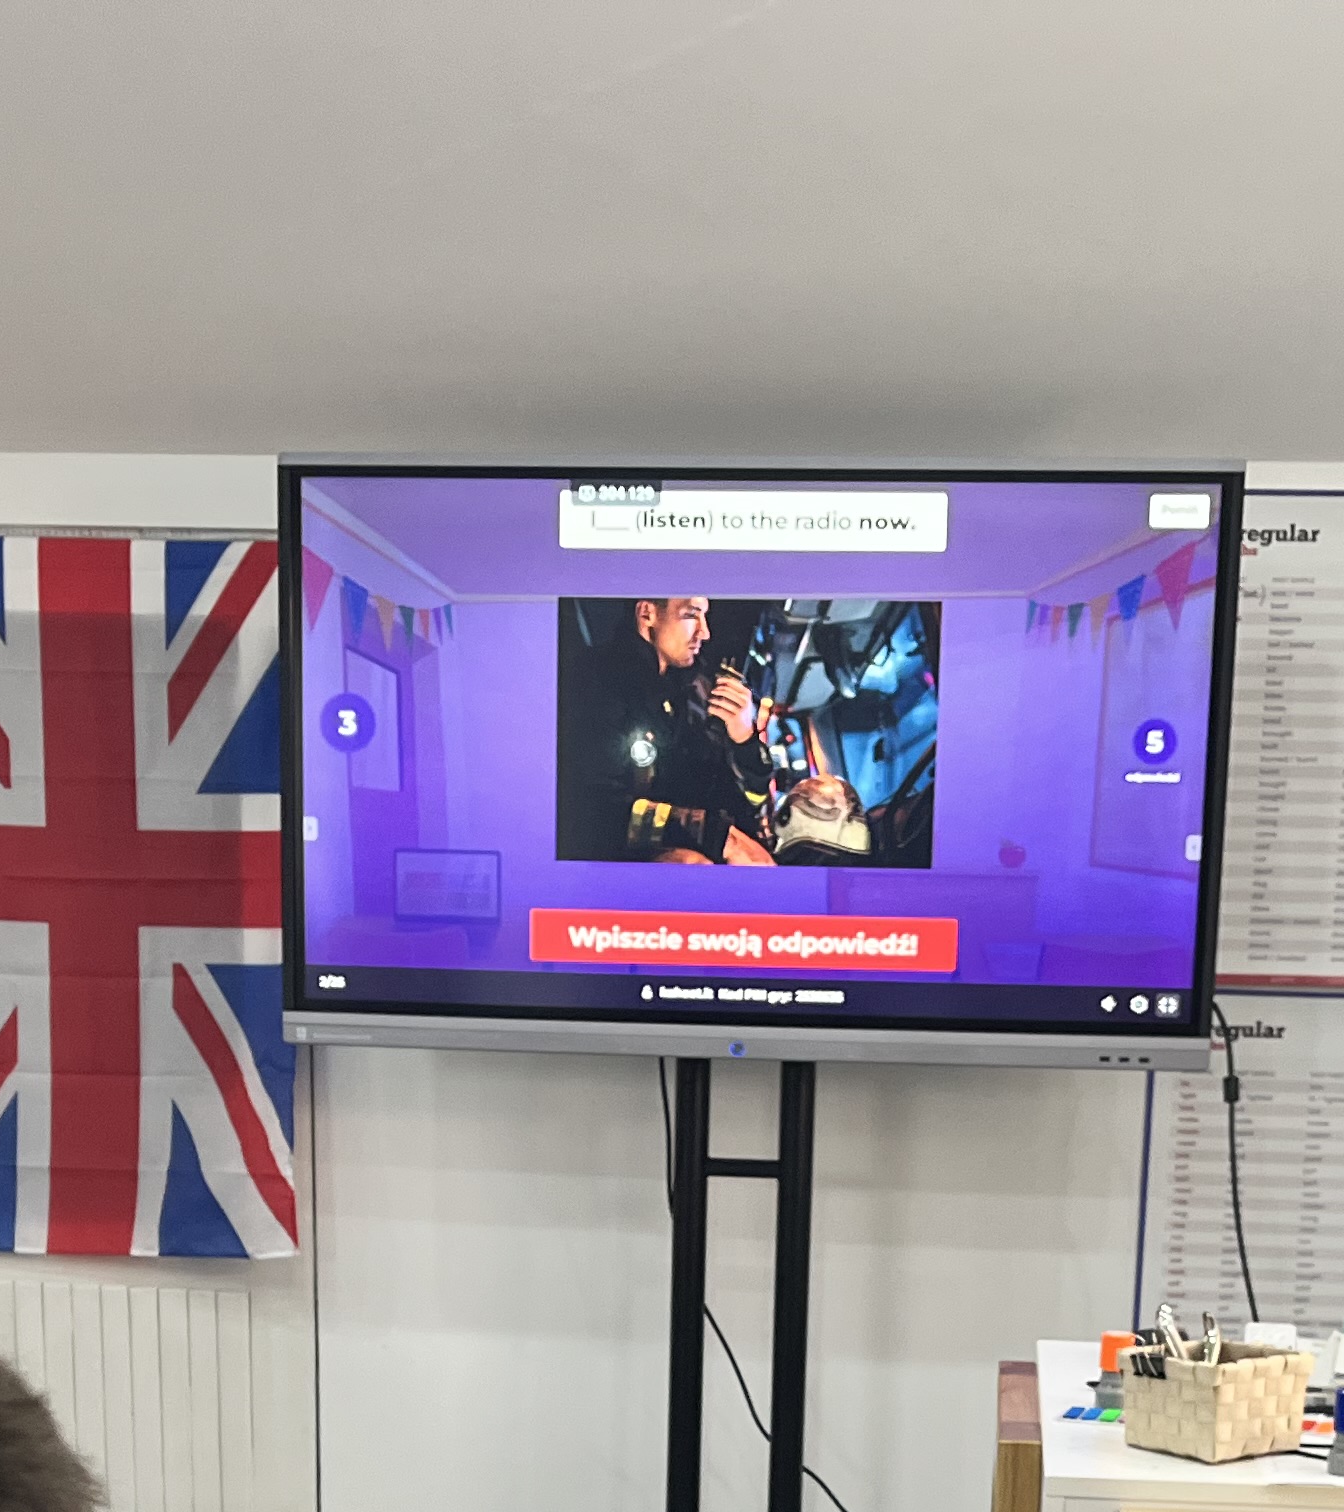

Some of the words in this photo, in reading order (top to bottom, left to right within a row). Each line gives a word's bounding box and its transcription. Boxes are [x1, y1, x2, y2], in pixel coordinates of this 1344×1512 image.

[636, 509, 714, 533] (listen)
[722, 512, 743, 530] to
[750, 511, 788, 531] the
[794, 510, 852, 531] radio
[859, 516, 916, 532] now.
[337, 709, 358, 736] 3
[1145, 729, 1165, 754] 5
[568, 925, 683, 952] Wpiszcie
[687, 928, 763, 958] swoją
[767, 931, 919, 958] odpowiedź!
